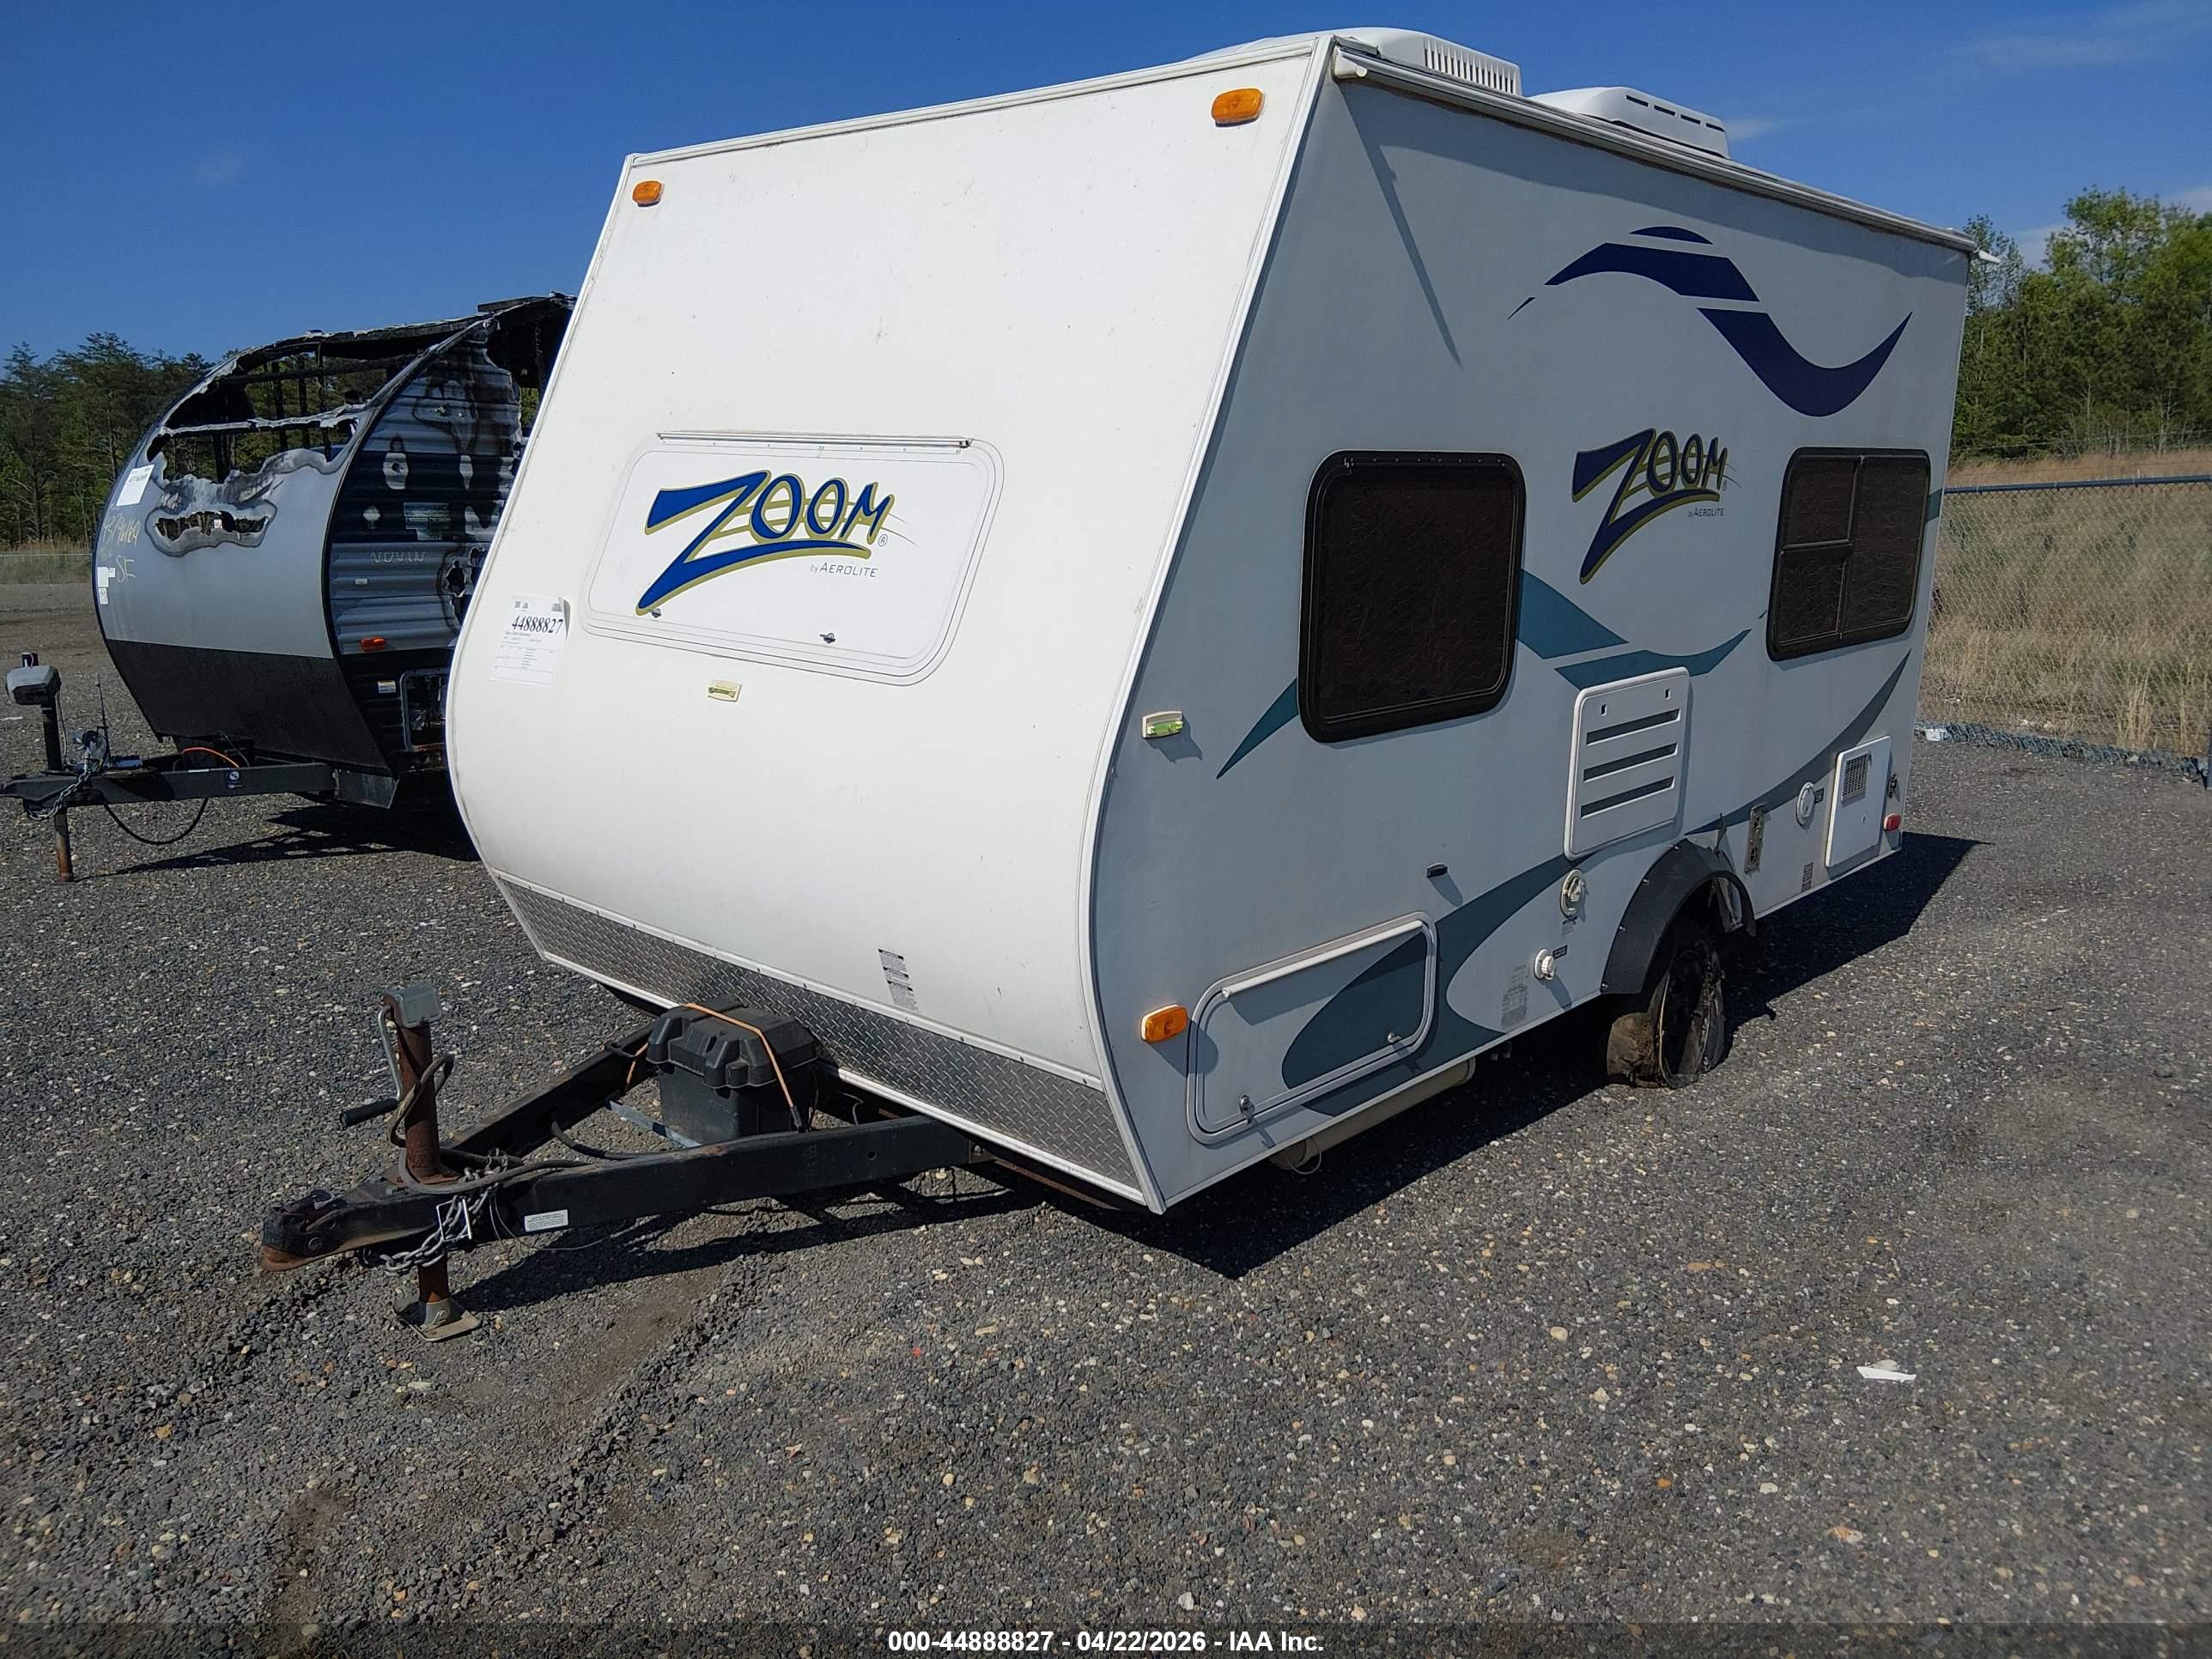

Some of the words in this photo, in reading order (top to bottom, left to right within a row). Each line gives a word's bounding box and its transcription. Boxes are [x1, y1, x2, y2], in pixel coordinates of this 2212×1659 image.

[1571, 428, 1728, 585] ZOOM
[1693, 507, 1725, 517] AEROLITE
[635, 470, 895, 616] ZOOM
[810, 563, 820, 574] by
[819, 562, 878, 578] AEROLITE
[511, 615, 563, 635] 44888827
